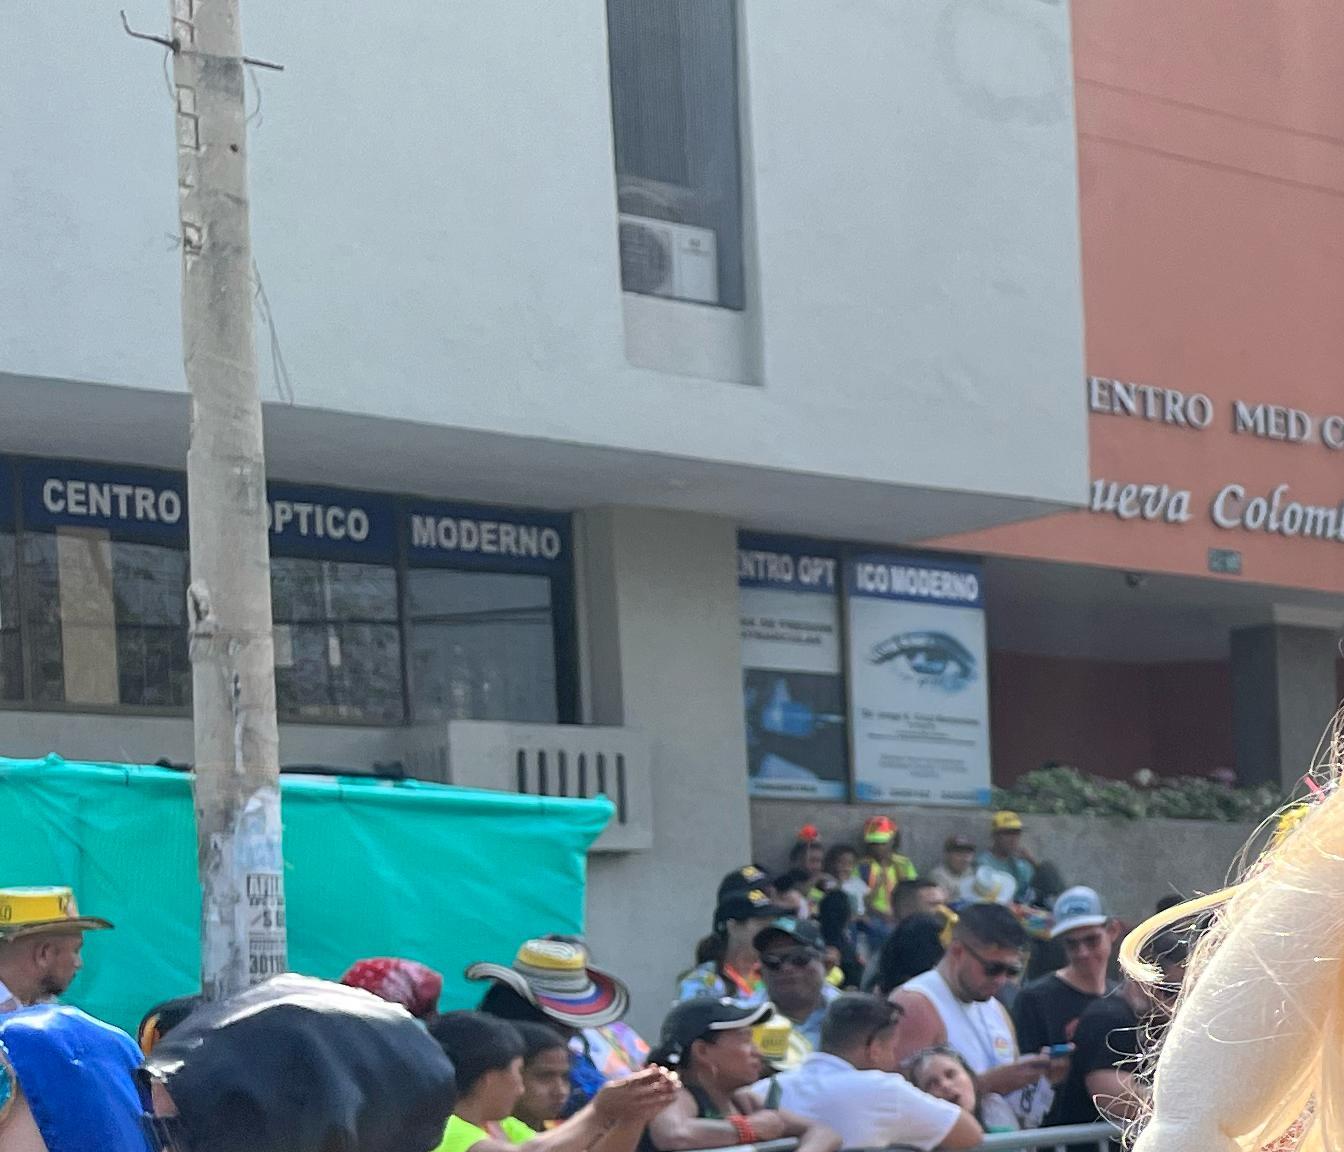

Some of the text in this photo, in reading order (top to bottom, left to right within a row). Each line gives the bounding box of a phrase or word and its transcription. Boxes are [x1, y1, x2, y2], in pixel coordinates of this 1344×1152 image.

[42, 478, 182, 524] CENTRO
[411, 513, 561, 560] MODERNO
[890, 564, 980, 602] MODERNO
